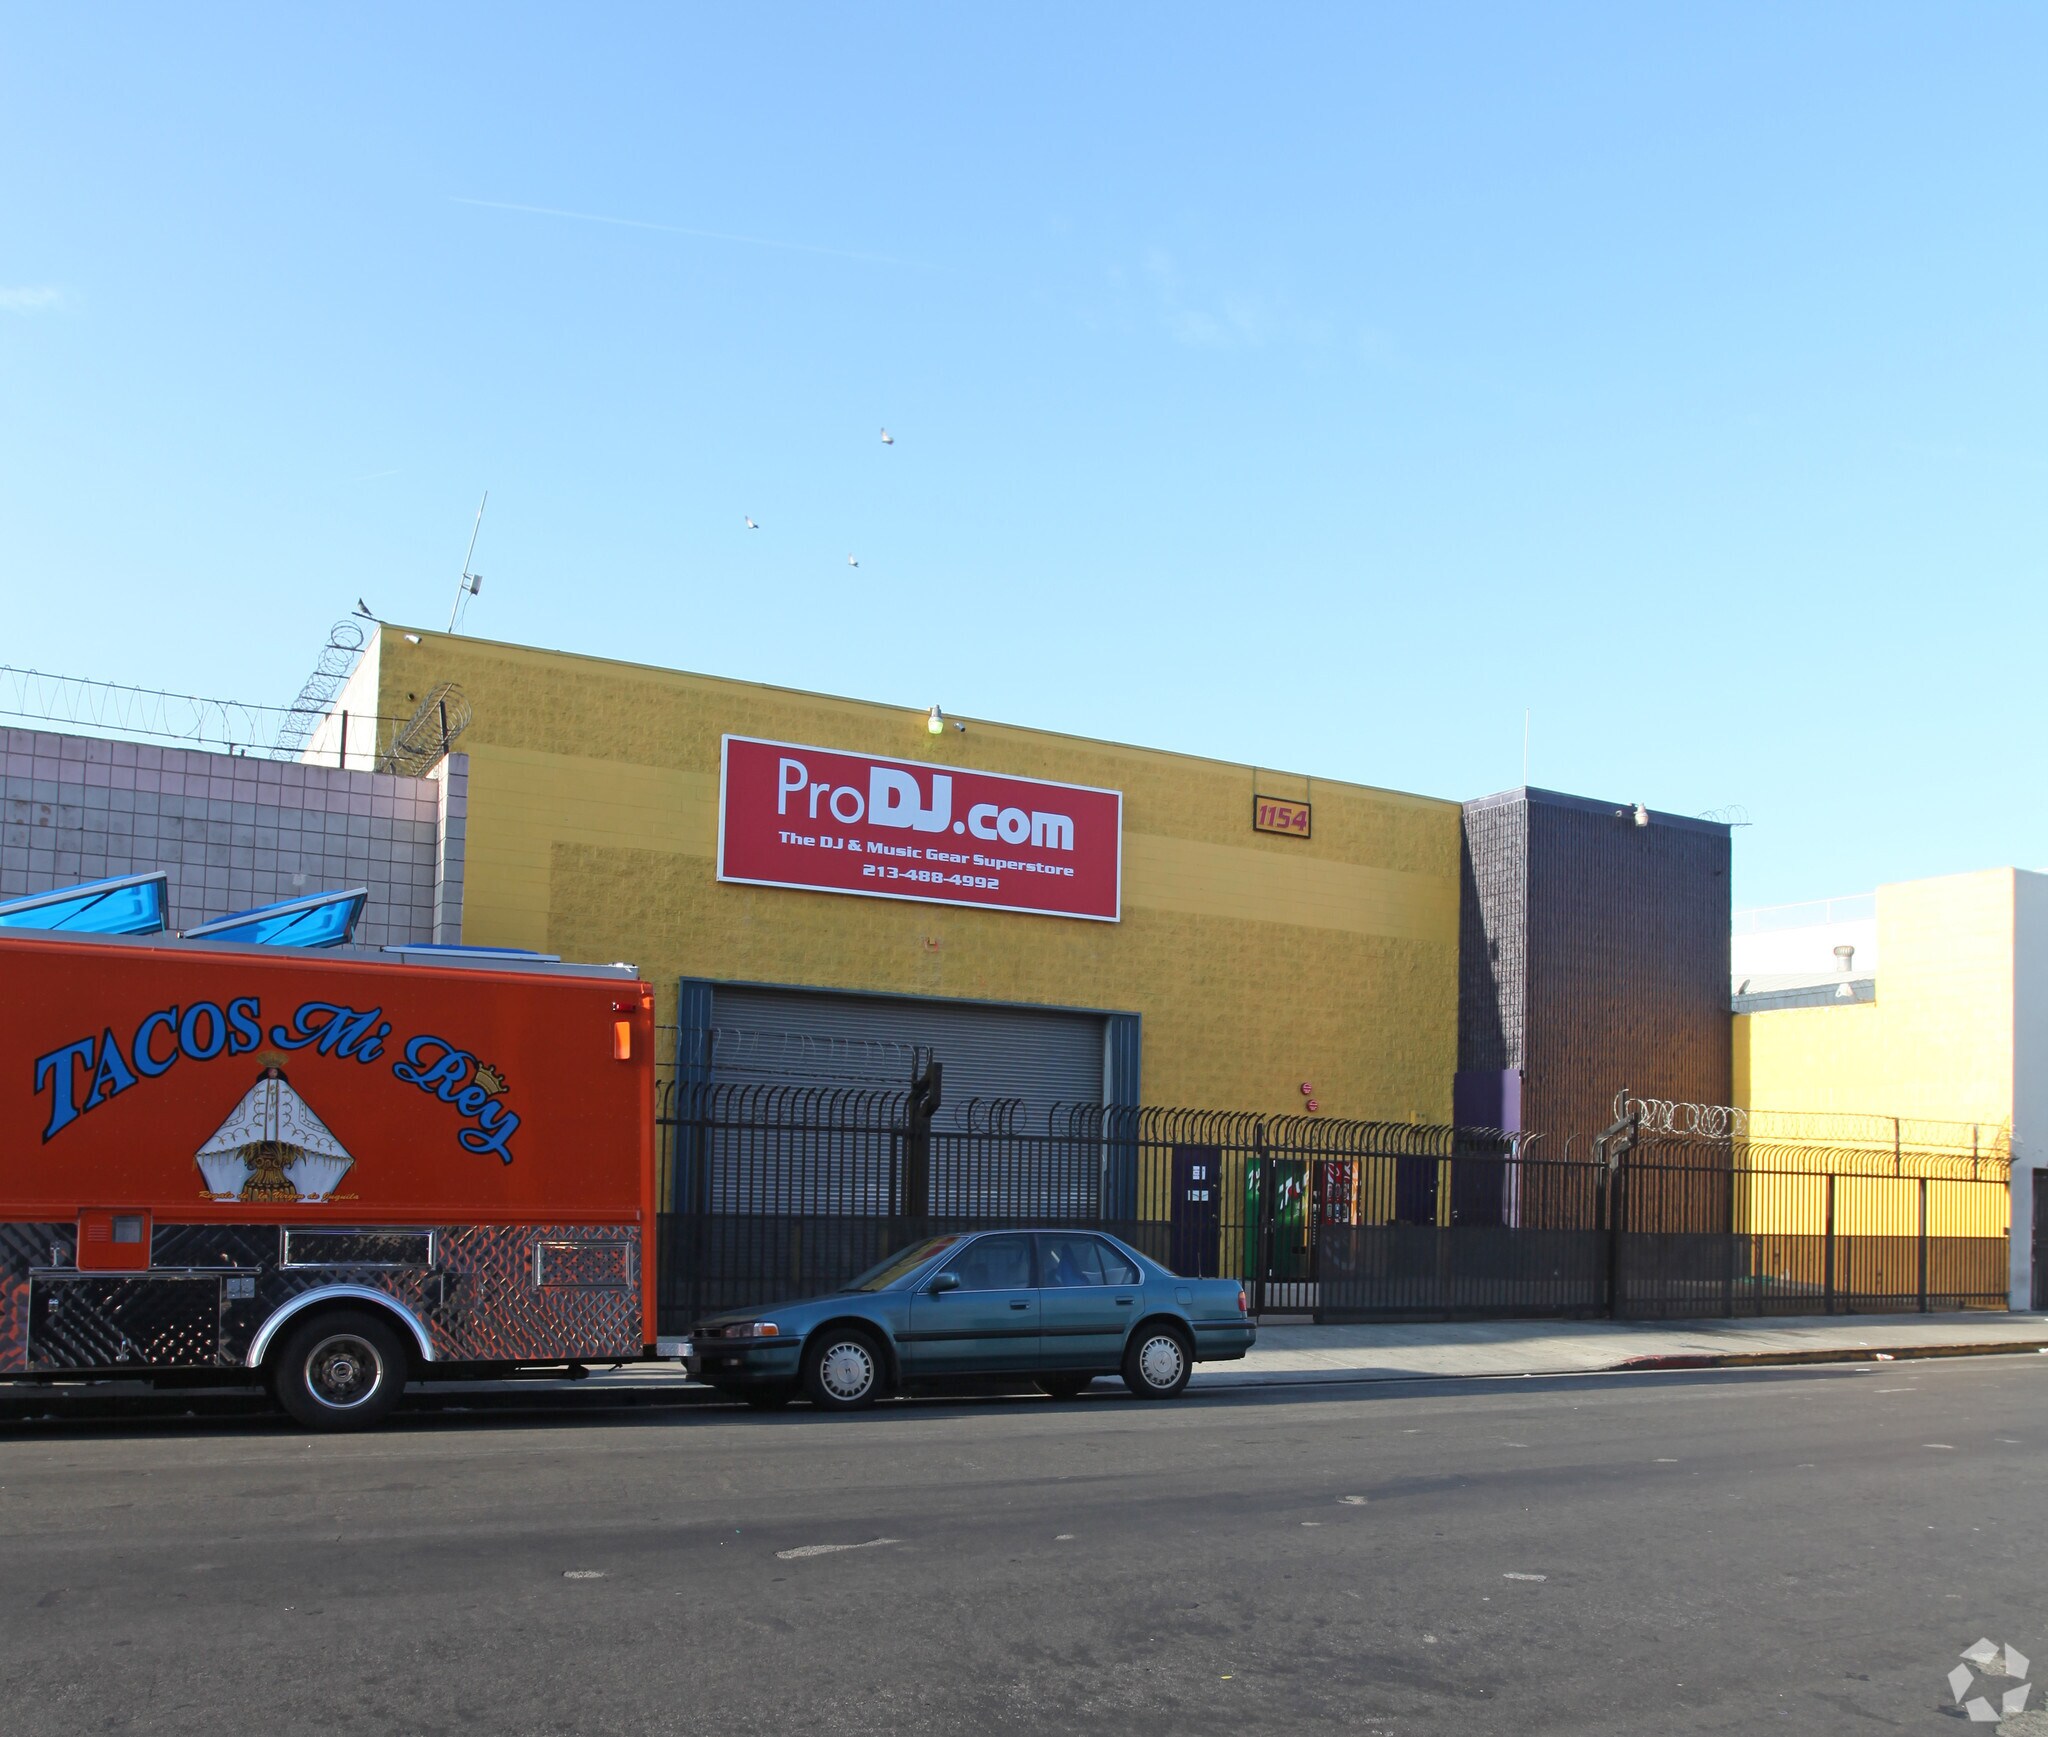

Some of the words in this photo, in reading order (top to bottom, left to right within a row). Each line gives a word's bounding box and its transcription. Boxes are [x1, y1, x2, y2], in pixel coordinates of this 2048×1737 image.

[778, 757, 1074, 851] ProDJ.com
[1258, 804, 1307, 832] 1154
[778, 831, 816, 847] The
[819, 835, 844, 850] DJ
[847, 839, 863, 852] &
[866, 841, 922, 859] Music
[925, 848, 970, 864] Gear
[973, 853, 1074, 877] Superstore
[862, 864, 1000, 890] 213-488-4992
[33, 996, 263, 1146] TACOS
[268, 1001, 393, 1064] Mi
[392, 1034, 521, 1166] Rey
[271, 1190, 306, 1201] Virgen
